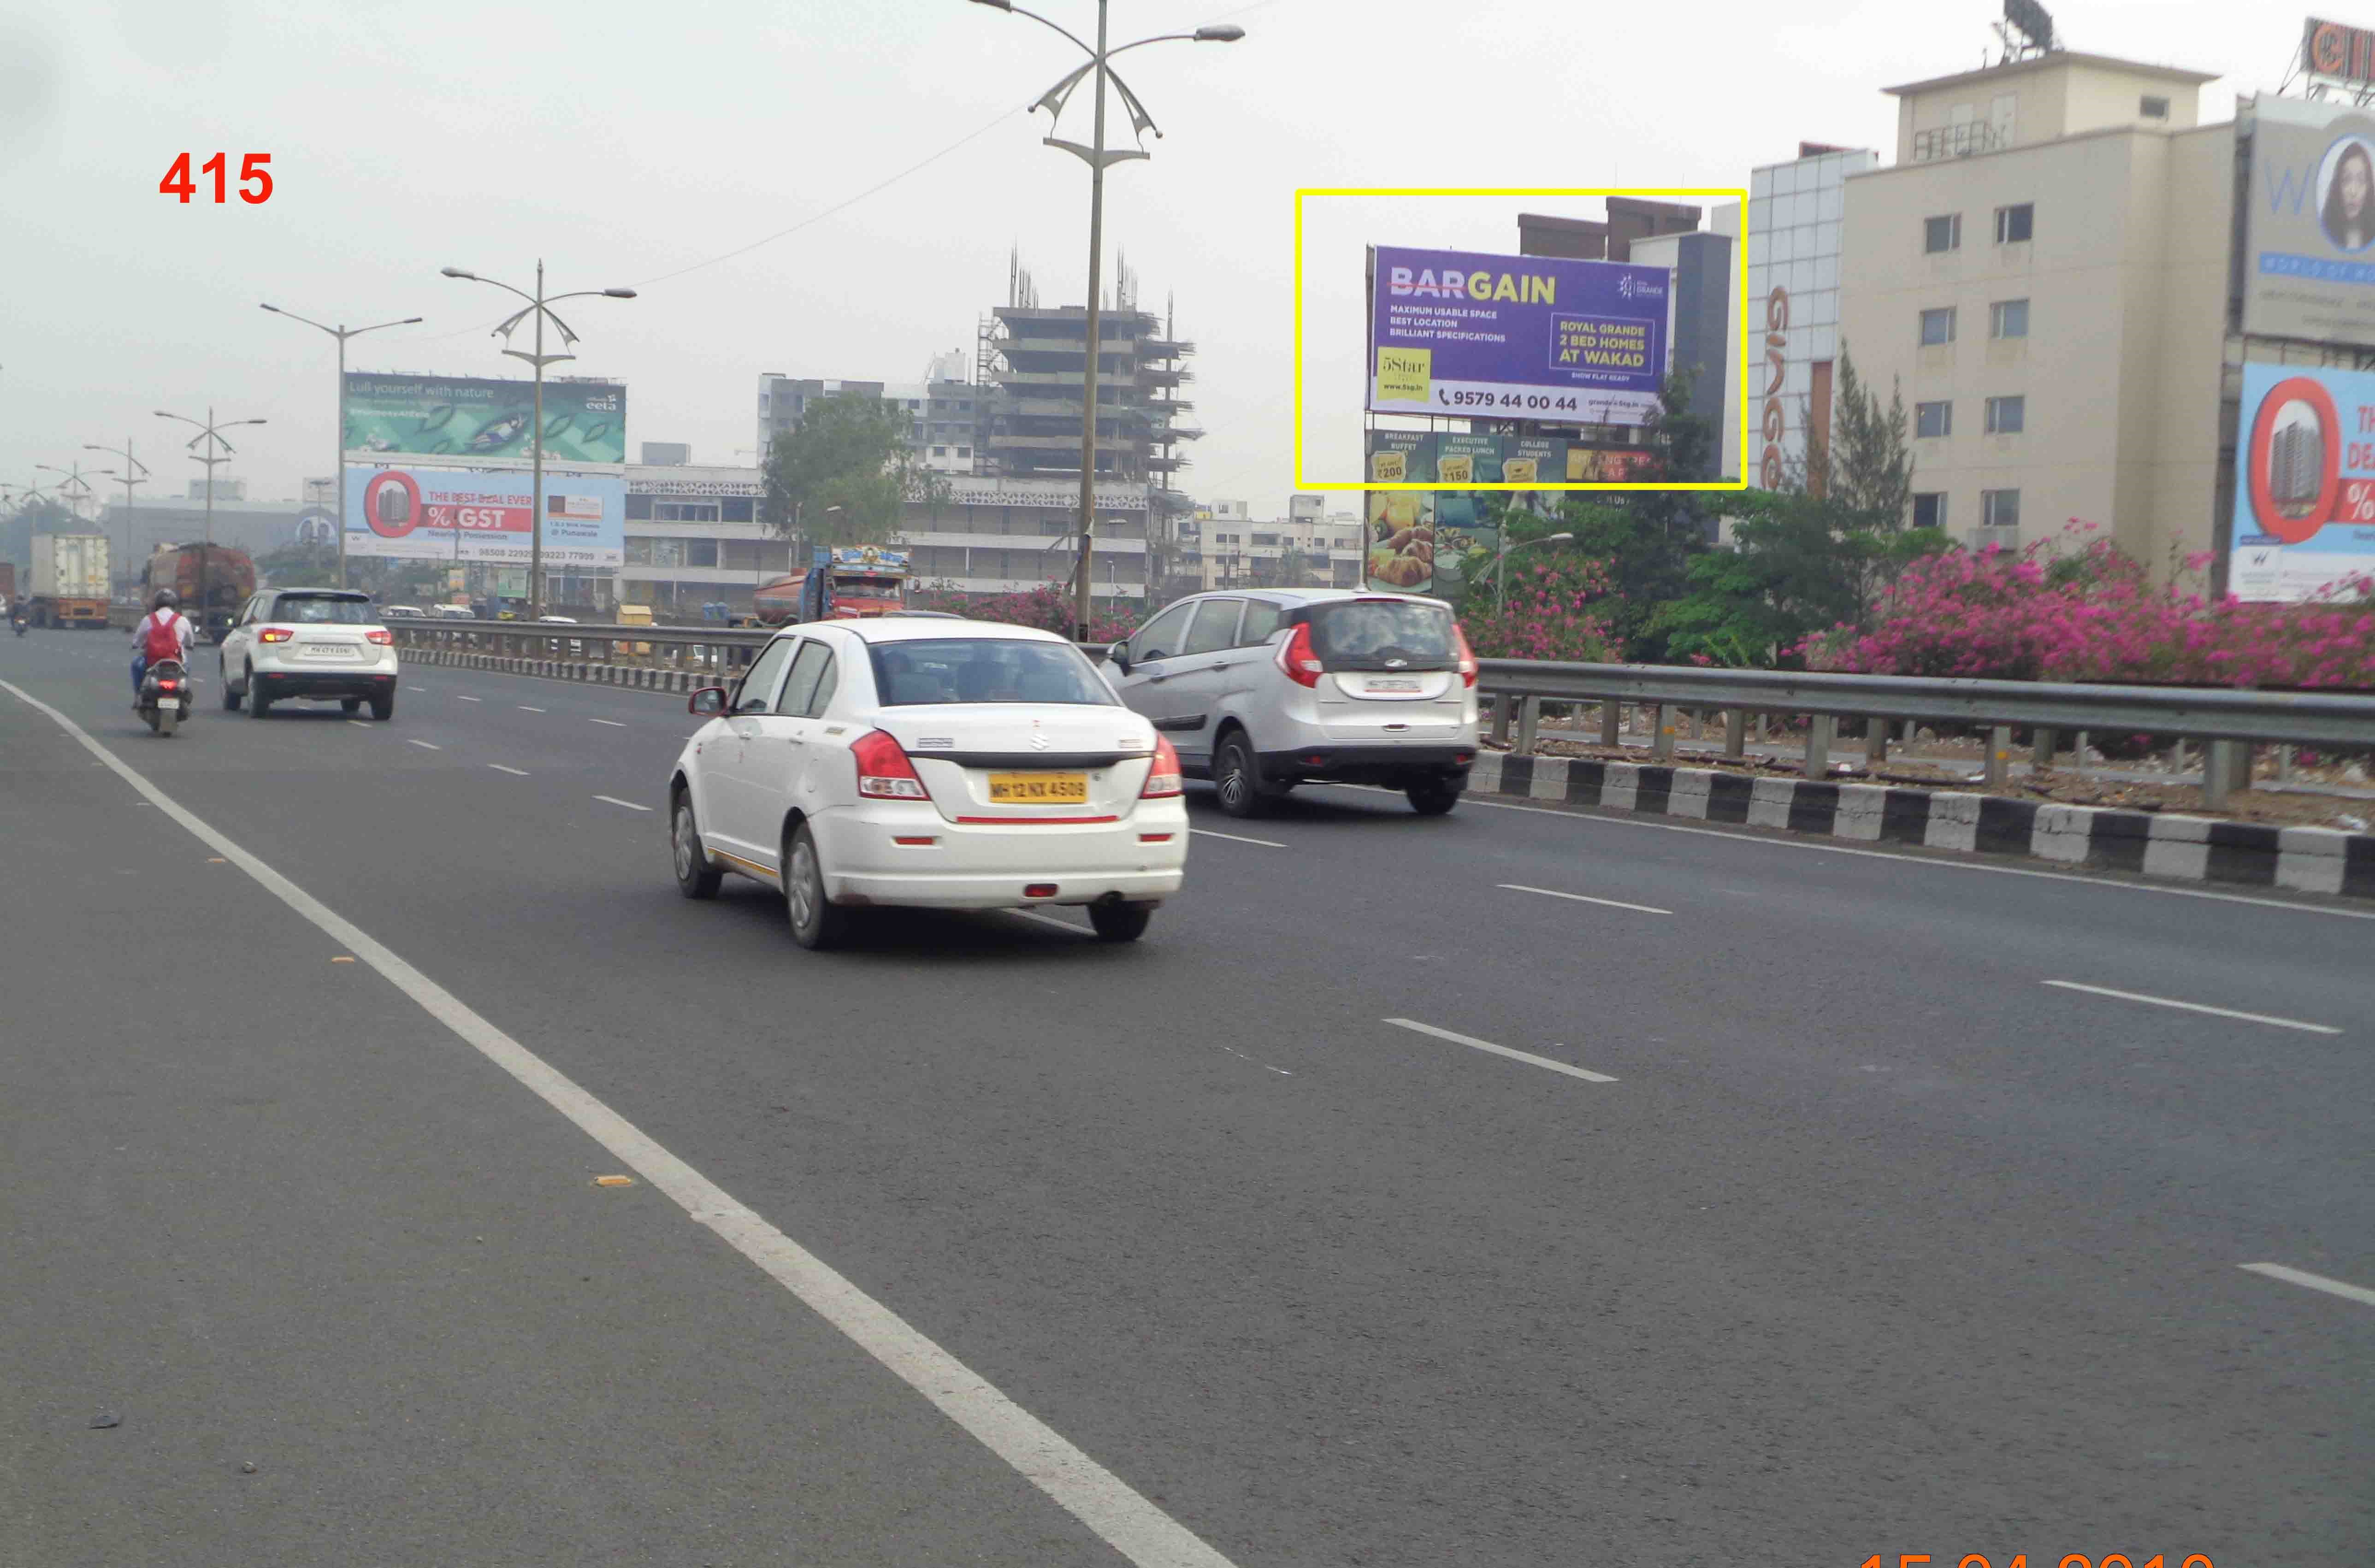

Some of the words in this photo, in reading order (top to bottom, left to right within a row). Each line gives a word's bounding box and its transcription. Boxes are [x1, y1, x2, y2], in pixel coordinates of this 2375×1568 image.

[1391, 266, 1555, 305] BARGAIN
[1390, 304, 1432, 315] MAXIMUM
[1434, 307, 1468, 318] USABLE
[1470, 310, 1498, 319] SPACE
[1390, 316, 1412, 325] BEST
[1413, 318, 1458, 328] LOCATION
[1560, 321, 1596, 333] ROYAL
[1599, 324, 1645, 336] GRANDE
[1389, 328, 1435, 338] BRILLIANT
[1436, 330, 1506, 343] SPECIFICATIONS
[1559, 334, 1568, 346] 2
[1570, 335, 1596, 348] BED
[1600, 337, 1645, 351] HOMES
[1383, 357, 1425, 373] 5Star
[1559, 349, 1580, 363] AT
[1584, 350, 1645, 367] WAKAD
[373, 383, 423, 395] yourself
[425, 385, 451, 397] with
[454, 387, 495, 398] nature
[1454, 391, 1495, 406] 9579
[1500, 394, 1522, 408] 44
[1527, 395, 1550, 409] 00
[1555, 396, 1577, 411] 44
[1384, 432, 1424, 442] BREAKFAST
[1452, 436, 1489, 445] EXECUTIVE
[1390, 442, 1417, 451] BUFFET
[1445, 445, 1471, 454] PACKED
[1472, 446, 1495, 455] LUNCH
[1520, 441, 1549, 449] COLLEGE
[1517, 449, 1552, 458] STUDENTS
[428, 491, 449, 502] THE
[452, 492, 477, 503] BEST
[507, 495, 532, 506] EVER
[458, 508, 506, 528] GST
[463, 531, 509, 540] Possession
[991, 783, 1010, 797] MH
[1012, 783, 1026, 797] 12
